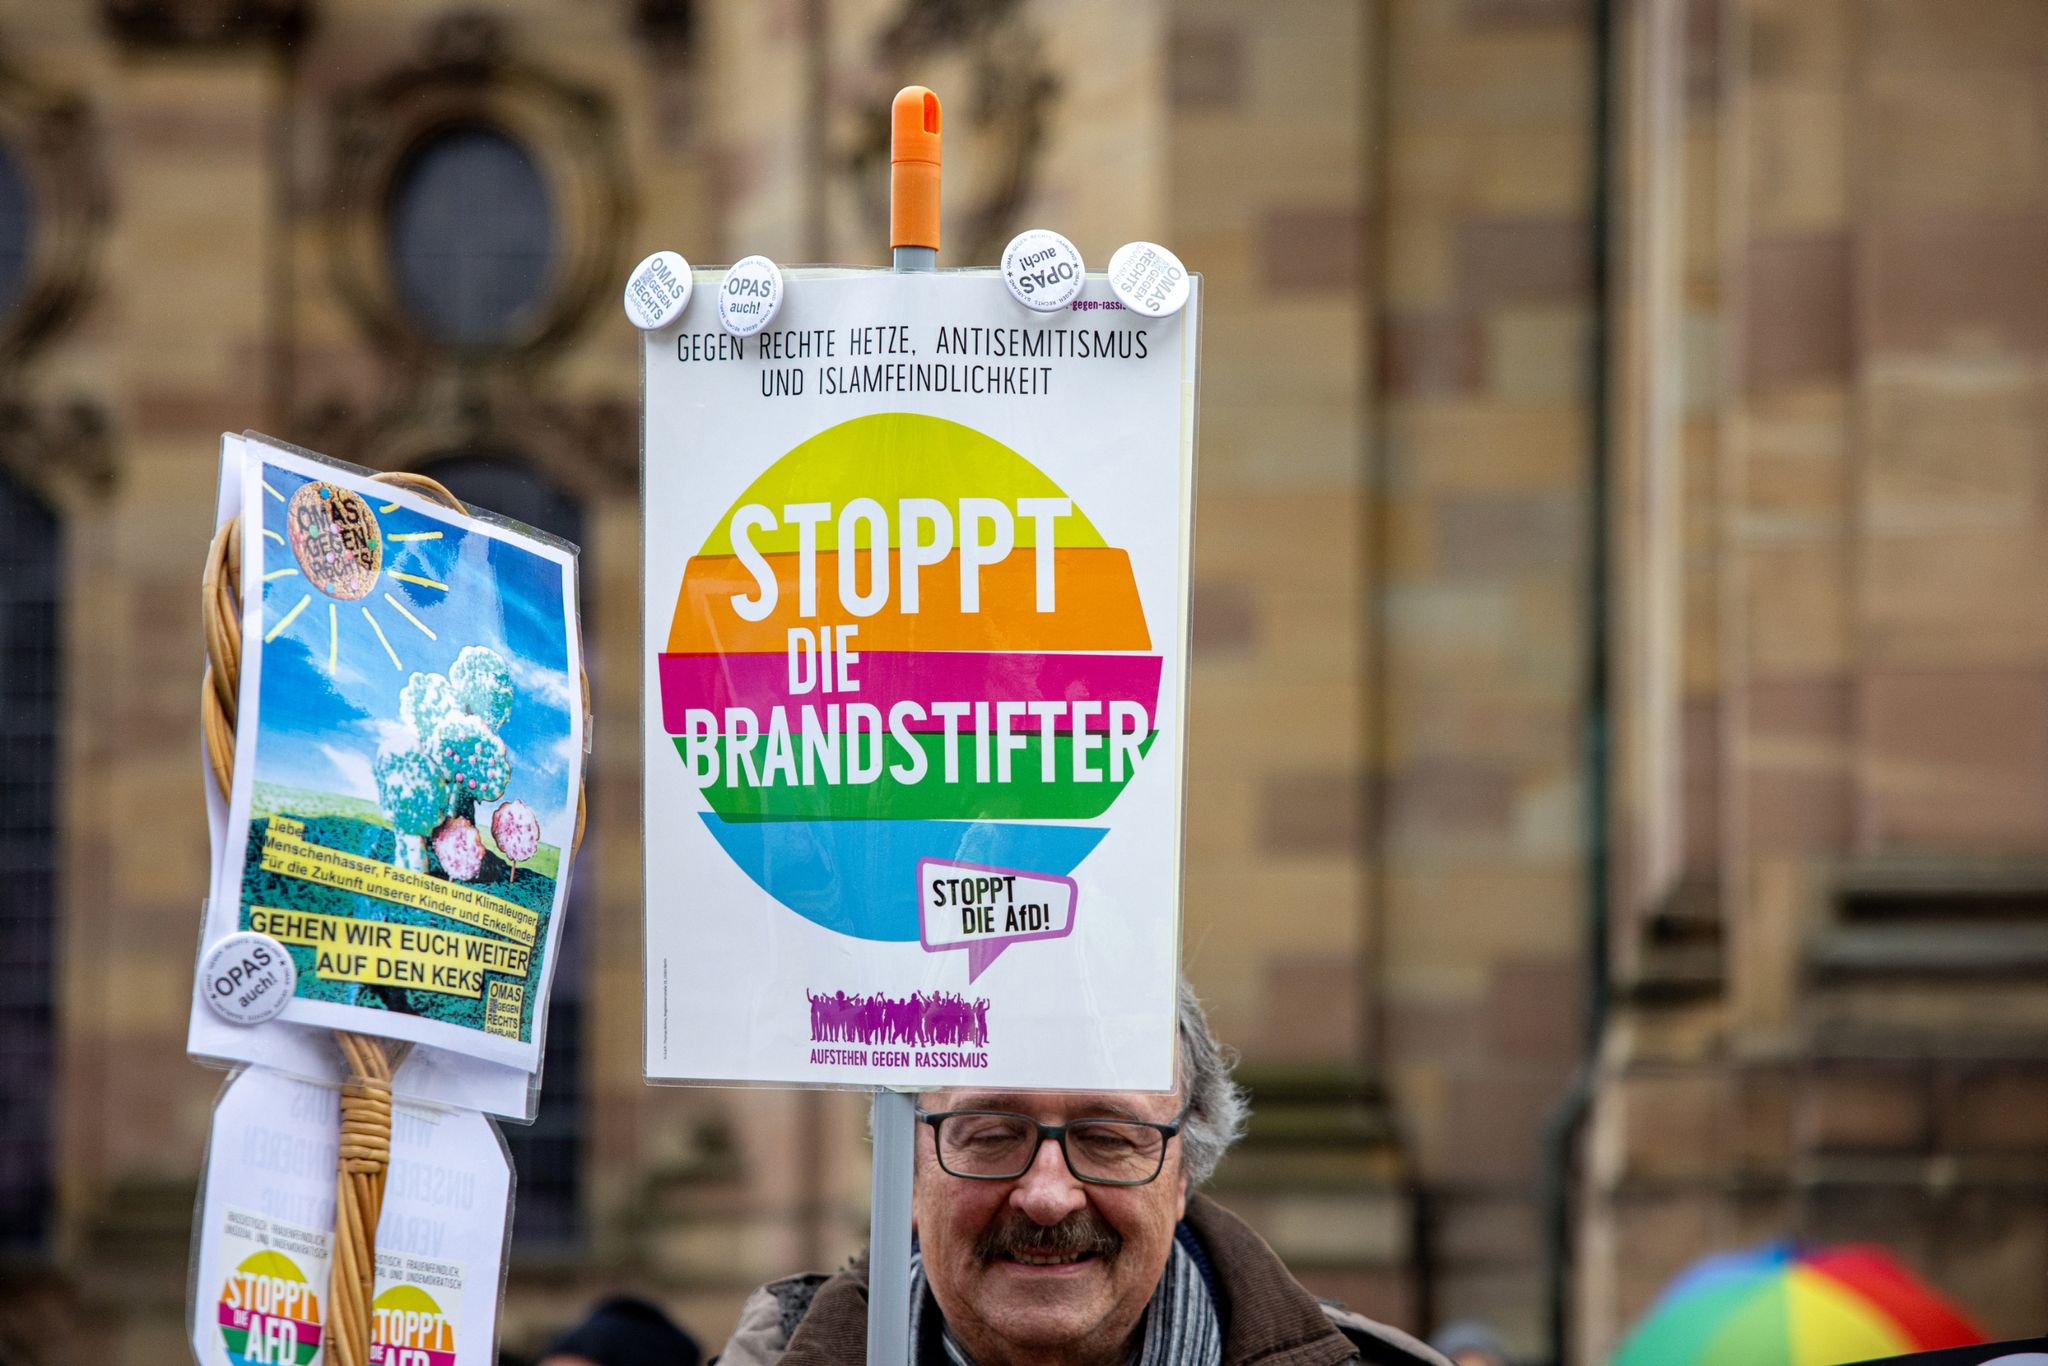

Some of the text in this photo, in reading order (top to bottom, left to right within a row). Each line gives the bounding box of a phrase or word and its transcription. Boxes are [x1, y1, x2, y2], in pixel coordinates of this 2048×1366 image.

[1018, 247, 1057, 271] auch!
[1019, 261, 1074, 294] OPAS
[1120, 248, 1157, 294] RECHTS
[648, 279, 673, 309] GEGEN
[650, 257, 685, 300] OMAS
[728, 277, 772, 298] OPAS
[1133, 270, 1161, 302] GEGEN
[1145, 266, 1183, 312] OMAS
[631, 279, 664, 320] RECHTS
[729, 302, 760, 315] auch!
[677, 325, 1148, 362] GEGEN RECHTE HETZE, ANTISEMITISMUS
[761, 363, 1052, 397] UND ISLAMFEINDLICHKEIT
[297, 497, 360, 534] OMAS
[307, 526, 368, 557] GEGEN
[729, 497, 1073, 623] STOPPT
[787, 624, 860, 695] DIE
[685, 700, 1151, 789] BRANDSTIFTER
[264, 835, 380, 878] Menschenhasser,
[383, 866, 448, 896] Faschisten
[451, 887, 472, 904] und
[262, 852, 535, 944] Für die Zukunft unserer Kinder und Enkelkinder
[932, 876, 1016, 907] STOPPT
[962, 903, 1050, 934] DIE AfD!
[250, 911, 529, 972] GEHEN WIR EUCH WEITER
[215, 947, 272, 996] OPAS
[238, 971, 278, 1008] auch!
[317, 952, 368, 977] AUF
[377, 958, 424, 983] DEN
[431, 966, 483, 993] KEKS
[490, 982, 522, 1002] OMAS
[497, 1002, 519, 1015] GEGEN
[487, 1013, 518, 1029] RECHTS
[809, 1048, 988, 1069] AUFSTEHEN GEGEN RASSISMUS
[226, 1270, 310, 1322] STOPPT
[233, 1309, 250, 1328] DIE
[243, 1314, 298, 1366] AFD
